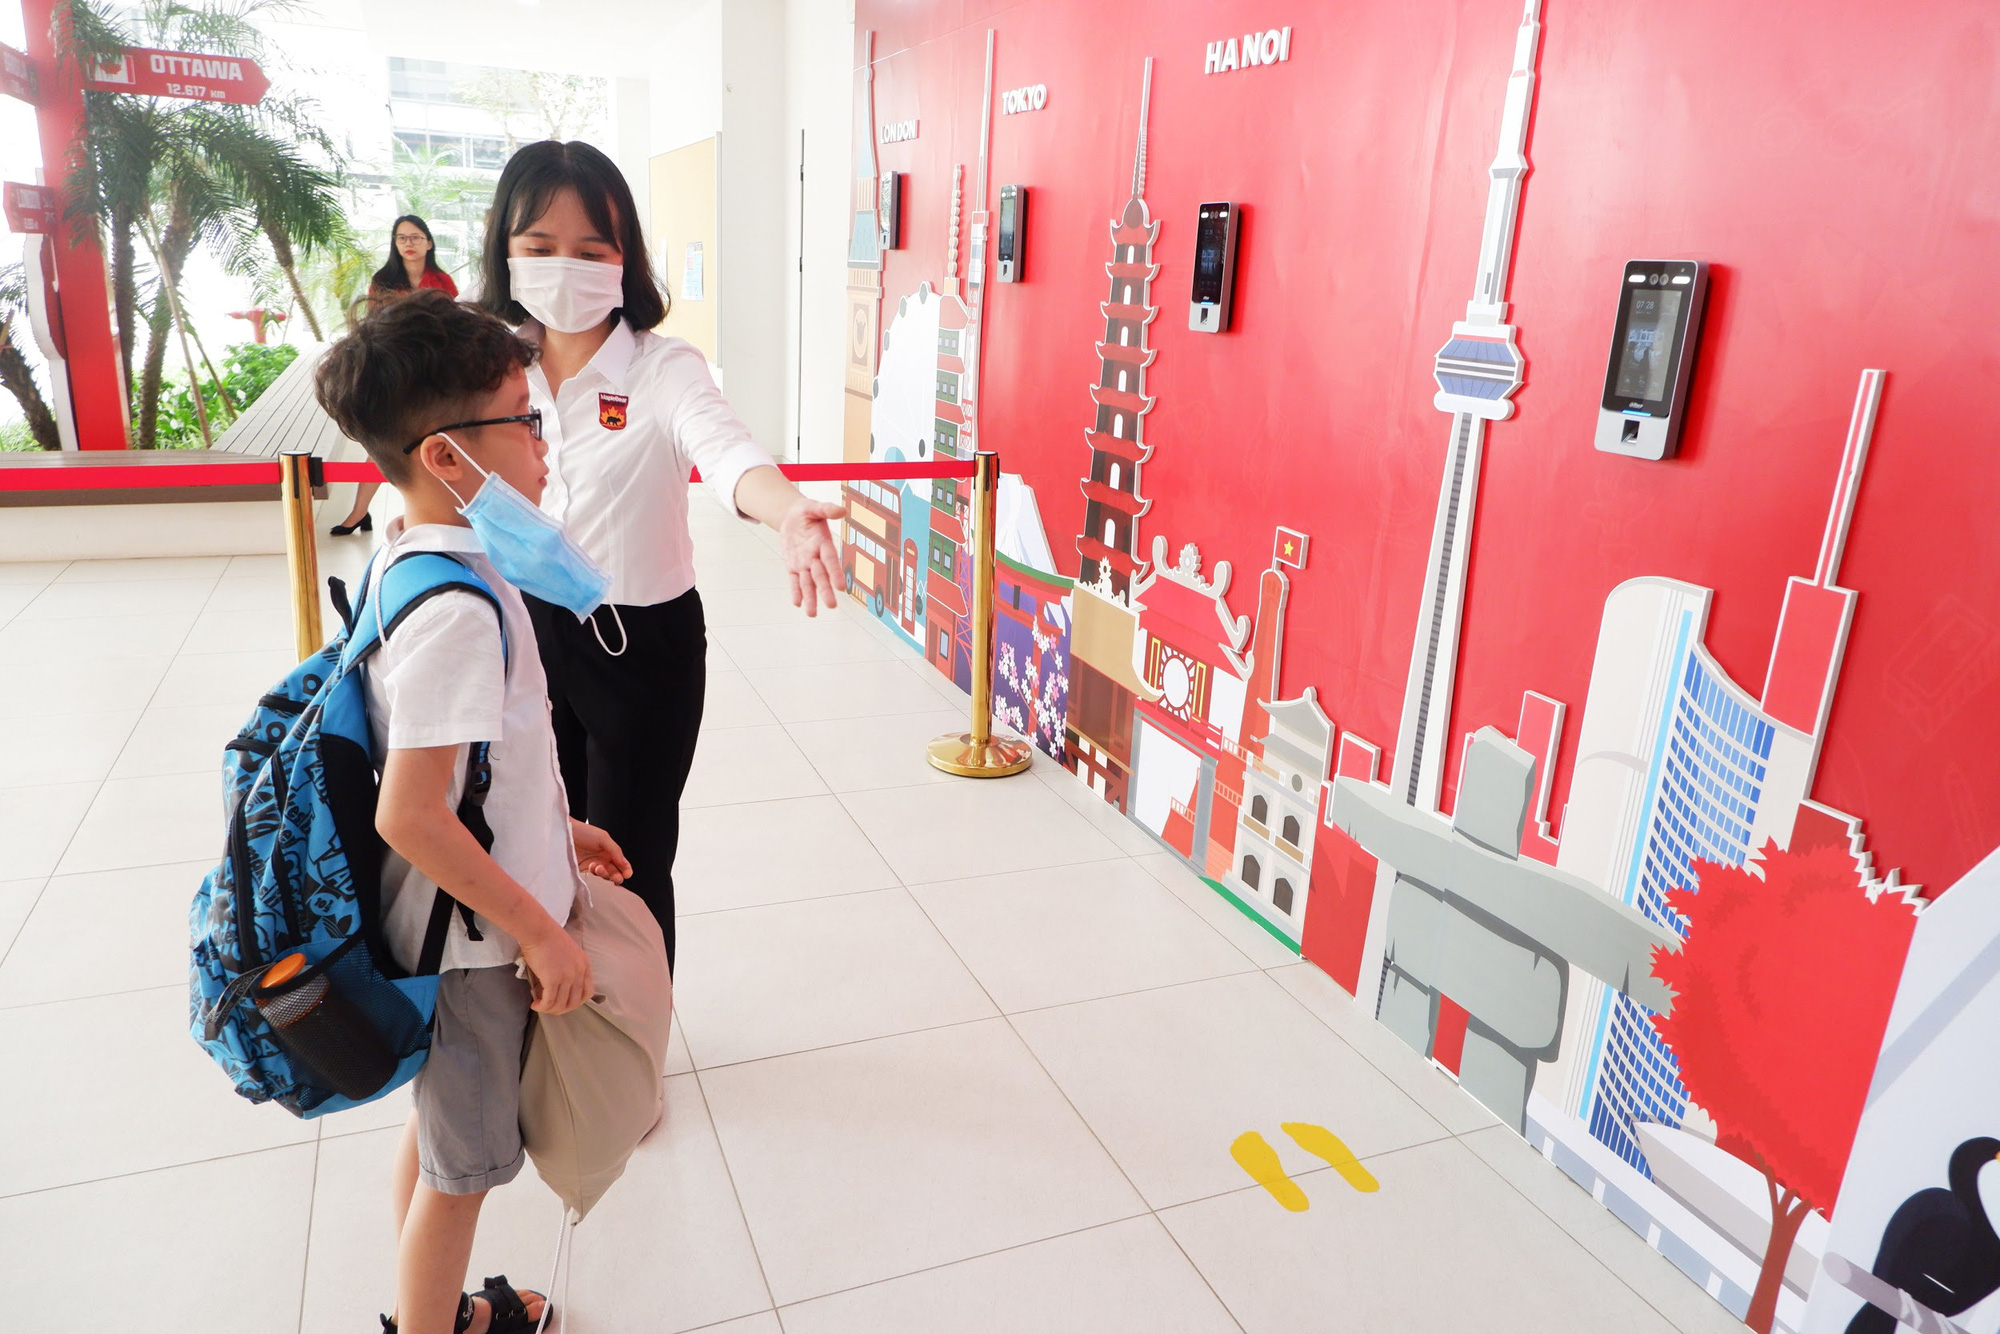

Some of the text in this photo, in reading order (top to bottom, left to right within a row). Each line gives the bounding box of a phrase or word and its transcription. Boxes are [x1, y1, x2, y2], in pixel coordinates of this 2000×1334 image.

[1204, 26, 1292, 75] HANOI
[150, 54, 244, 81] OTTAWA
[166, 83, 206, 97] 12.617
[1002, 83, 1047, 116] TOKYO
[880, 119, 918, 144] LONDON
[1636, 300, 1655, 310] 0728
